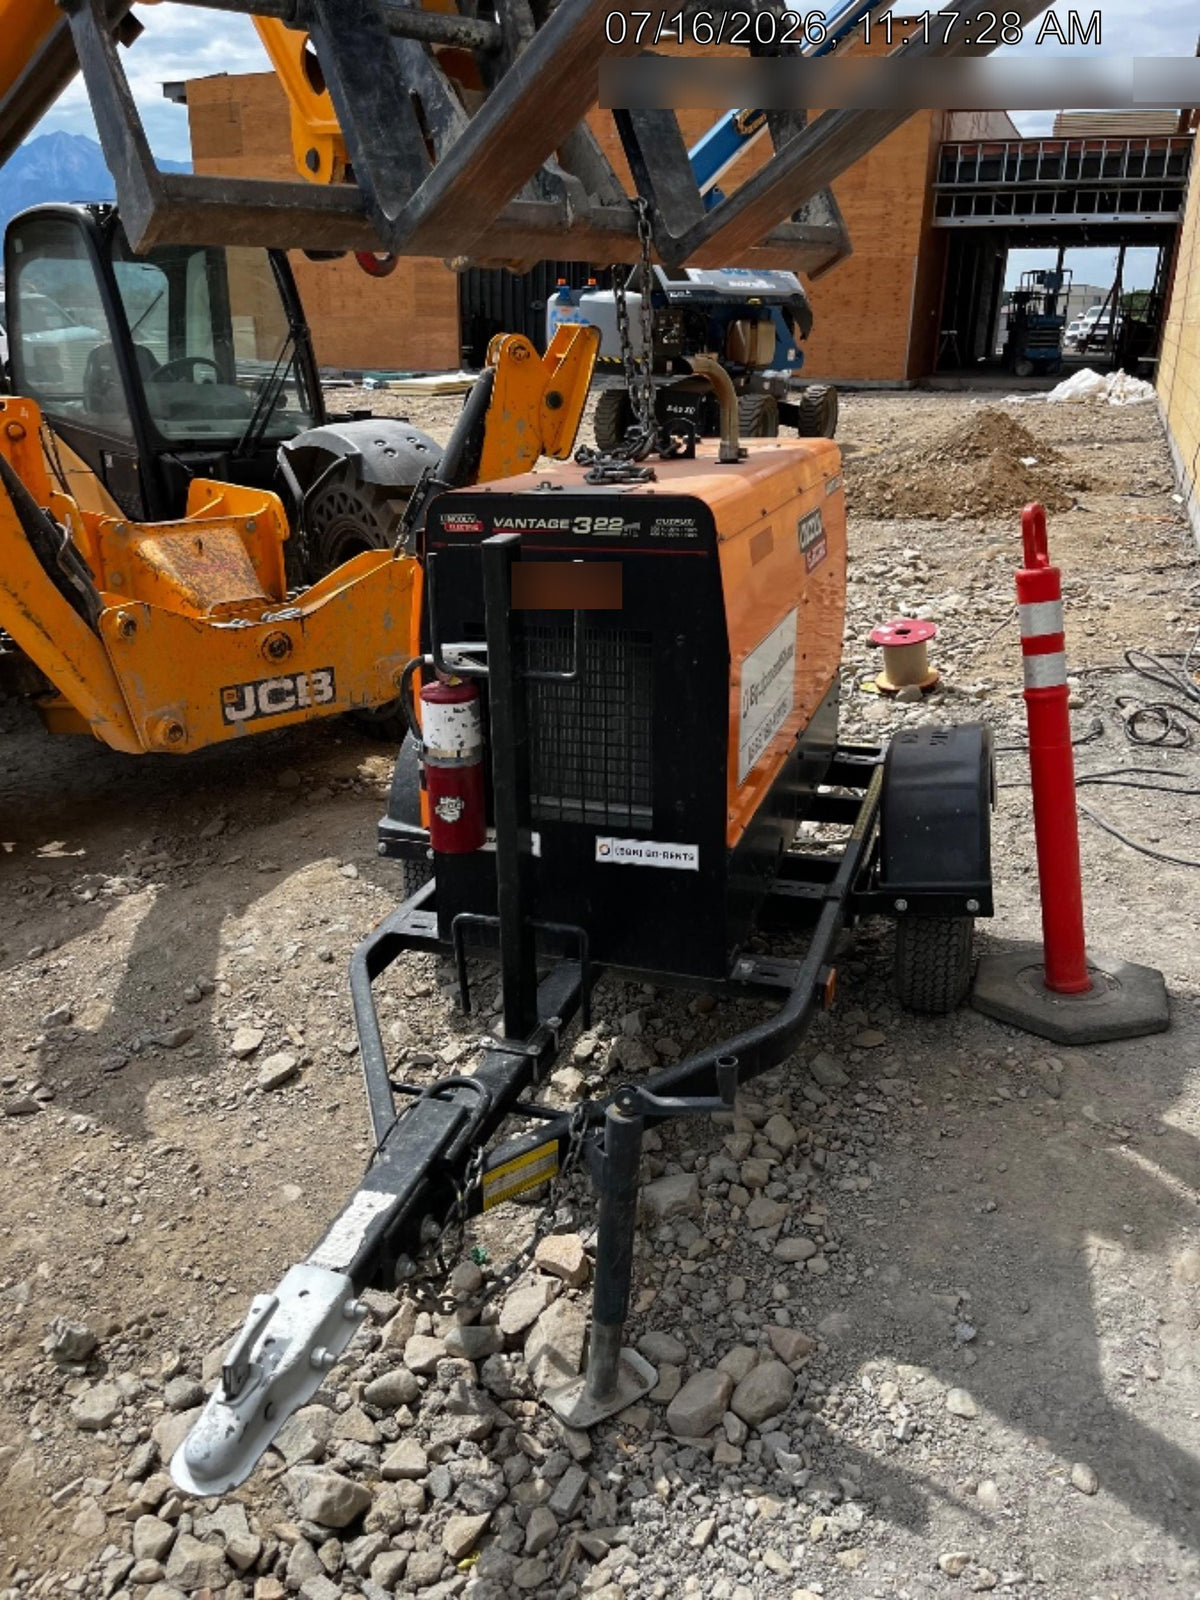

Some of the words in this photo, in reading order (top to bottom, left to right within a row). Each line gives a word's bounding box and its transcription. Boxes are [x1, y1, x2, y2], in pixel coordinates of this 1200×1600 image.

[492, 517, 570, 529] VANTAGE
[572, 516, 625, 535] 322
[224, 671, 333, 721] JCB
